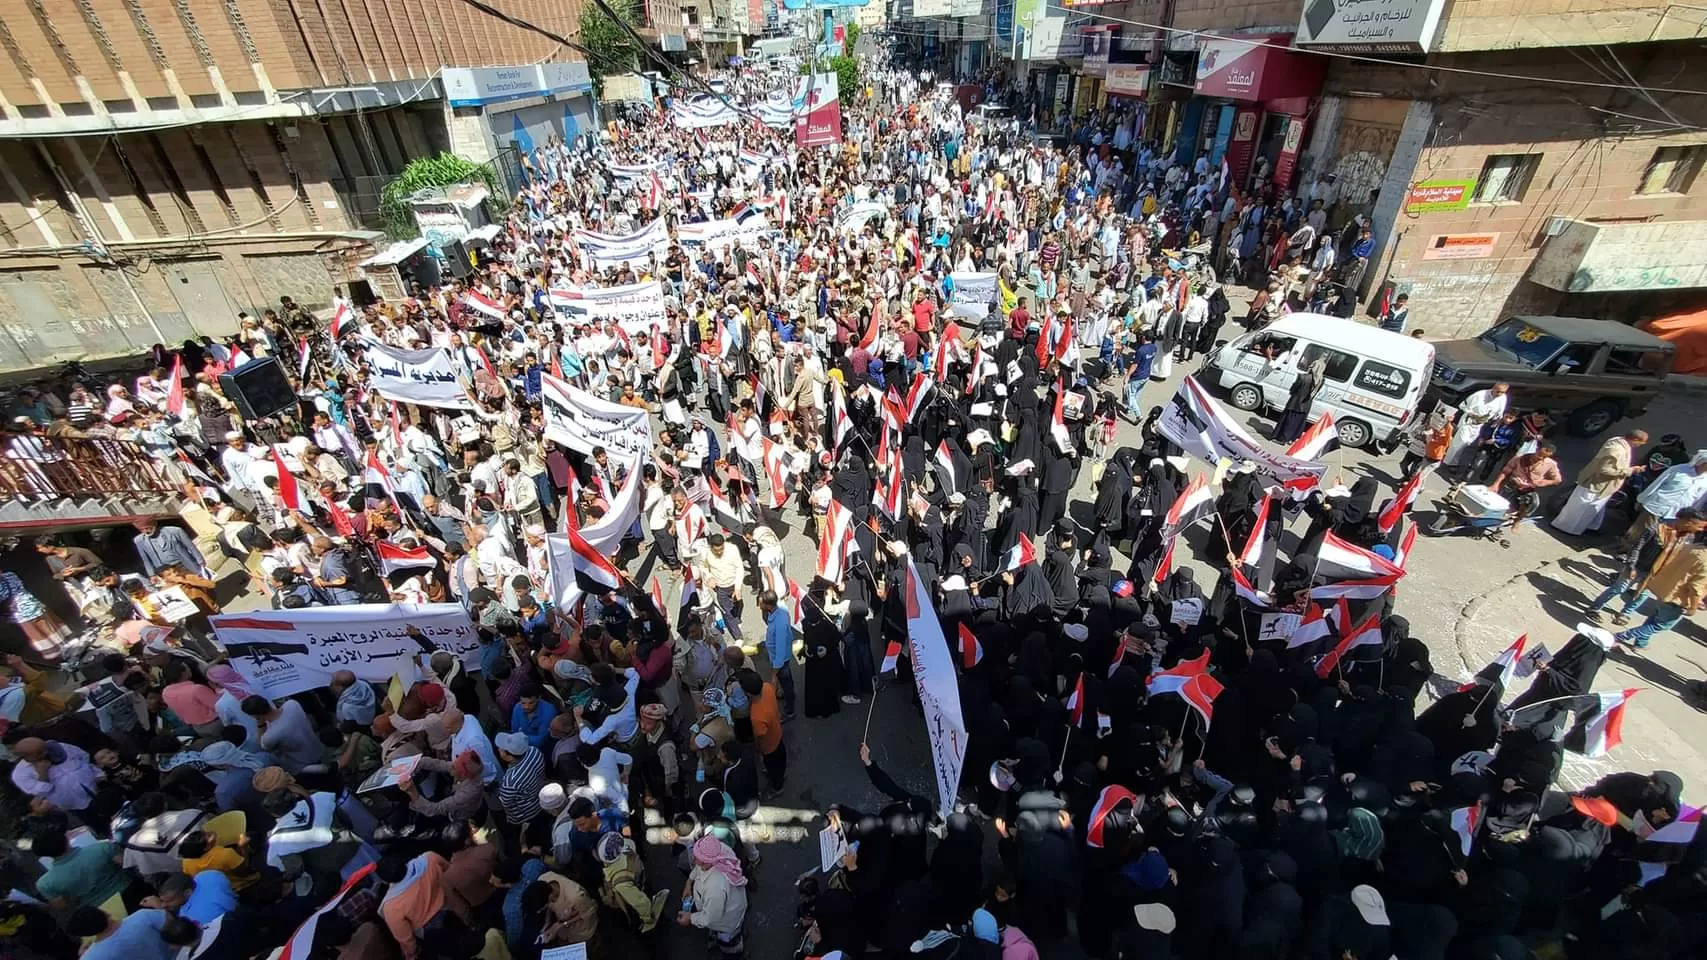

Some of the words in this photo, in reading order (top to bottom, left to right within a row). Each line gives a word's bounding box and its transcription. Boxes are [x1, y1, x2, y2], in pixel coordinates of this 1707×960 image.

[1382, 8, 1412, 23] للرخام
[1348, 26, 1388, 39] السيراميك
[411, 368, 456, 385] مديرية
[350, 629, 383, 645] الروح
[428, 625, 470, 638] الوحدة
[306, 632, 348, 647] المعبرة
